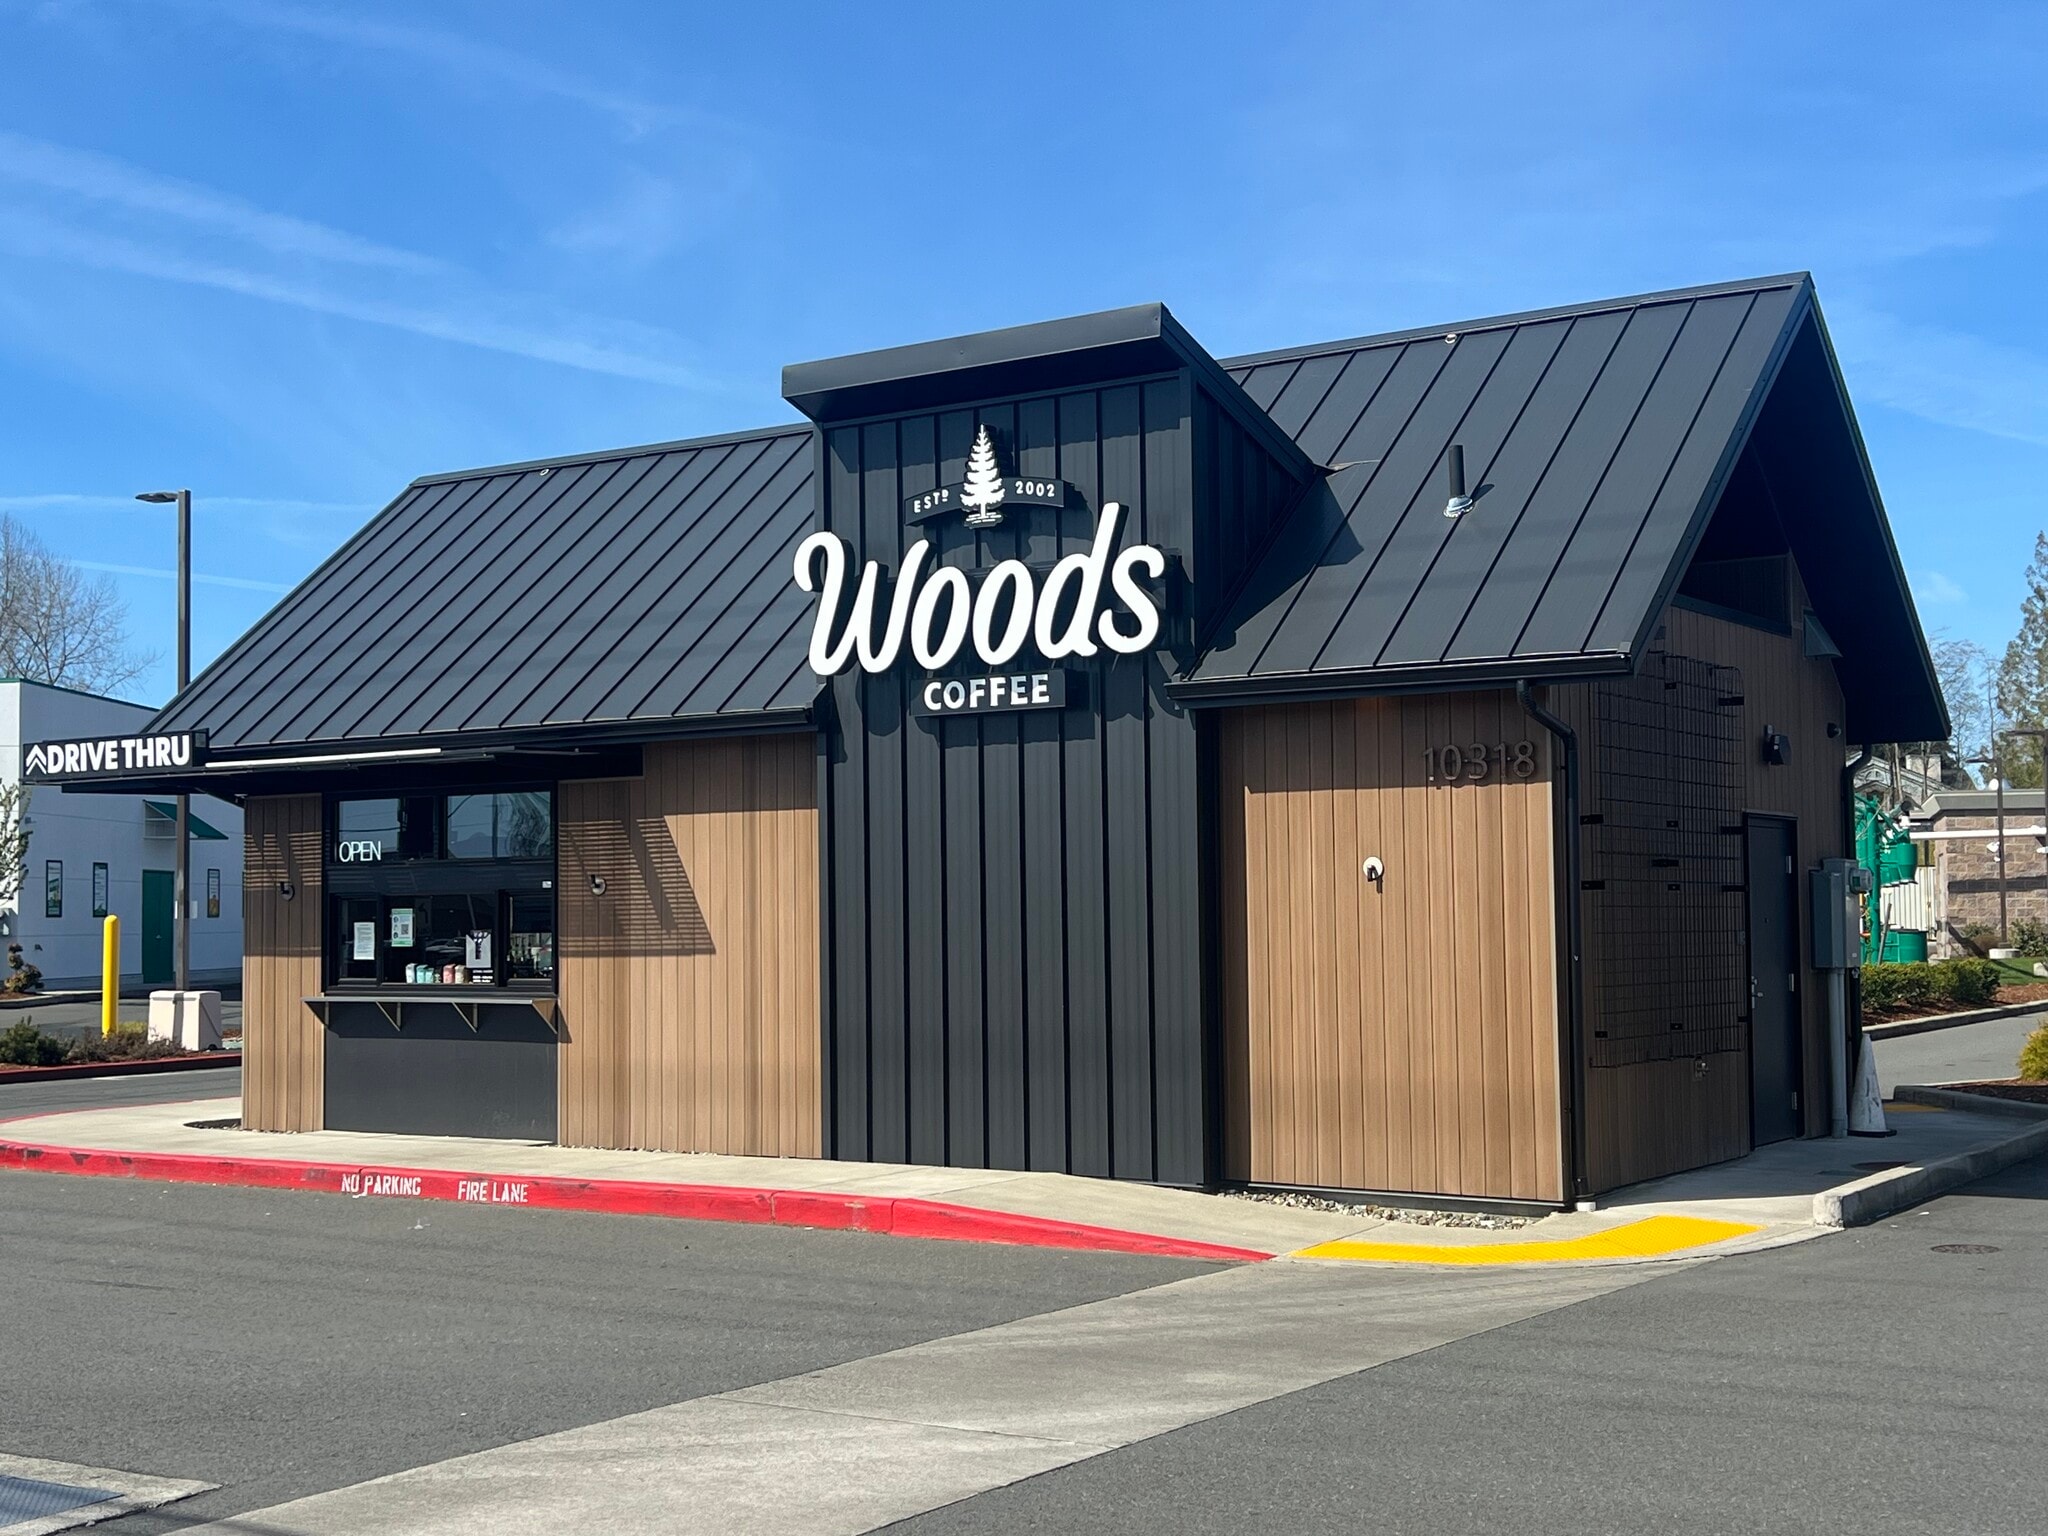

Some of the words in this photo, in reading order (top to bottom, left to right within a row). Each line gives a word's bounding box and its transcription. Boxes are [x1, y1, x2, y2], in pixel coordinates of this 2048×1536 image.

[1015, 481, 1055, 497] 2002
[793, 502, 1165, 676] Woods
[923, 674, 1050, 711] COFFEE
[47, 740, 118, 774] DRIVE
[121, 735, 190, 769] THRU
[1423, 740, 1535, 781] 10318
[338, 840, 382, 863] OPEN
[341, 1173, 360, 1193] NO
[364, 1175, 422, 1197] PARKING
[457, 1180, 488, 1202] FIRE
[492, 1182, 529, 1203] LANE
